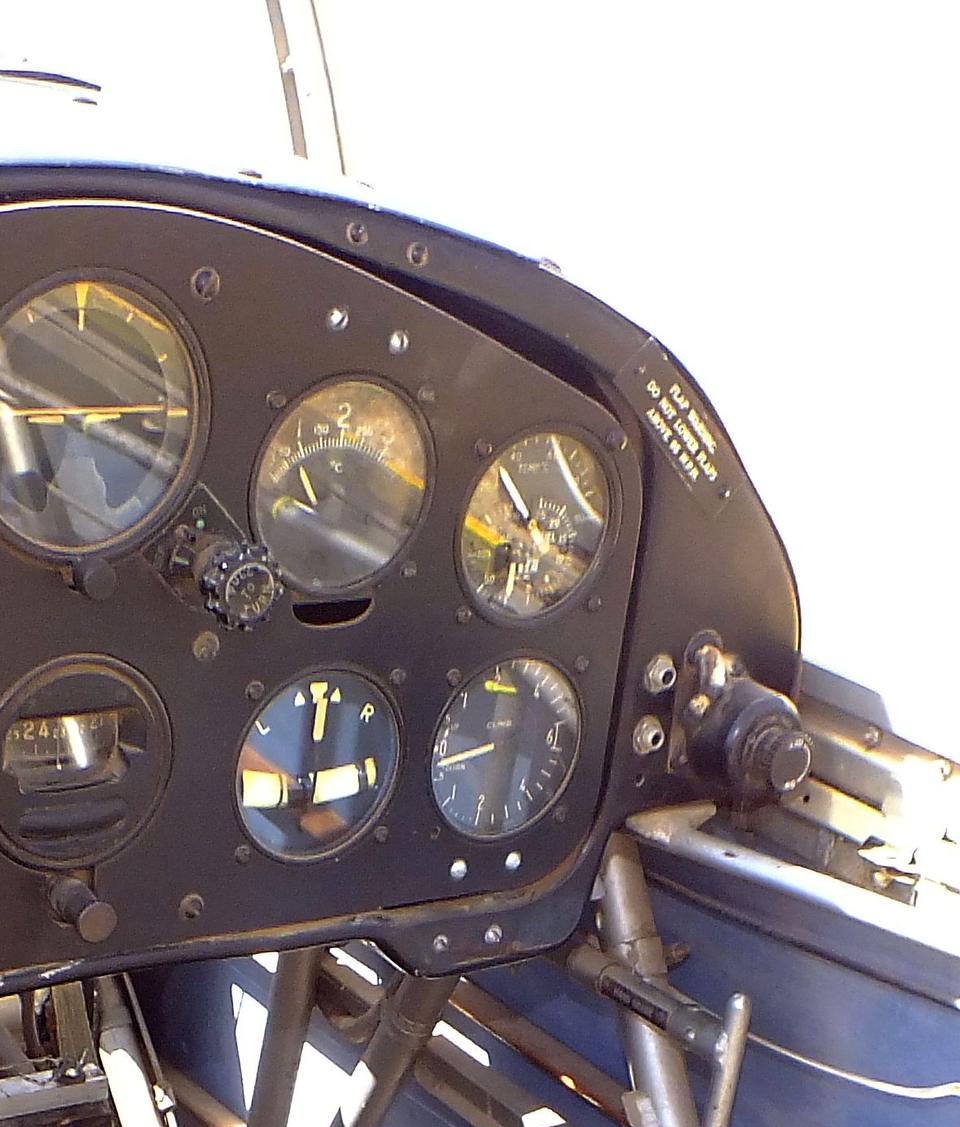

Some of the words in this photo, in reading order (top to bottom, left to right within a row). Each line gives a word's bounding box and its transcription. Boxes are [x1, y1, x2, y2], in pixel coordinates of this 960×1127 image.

[669, 383, 690, 410] FLAP
[337, 402, 352, 429] 2
[646, 408, 672, 442] ABOVE
[646, 378, 660, 398] DO
[659, 397, 677, 419] NOT
[673, 418, 699, 455] LOWER
[696, 450, 718, 481] FLAPS
[359, 702, 375, 724] R
[23, 719, 49, 740] 24
[255, 720, 271, 736] L
